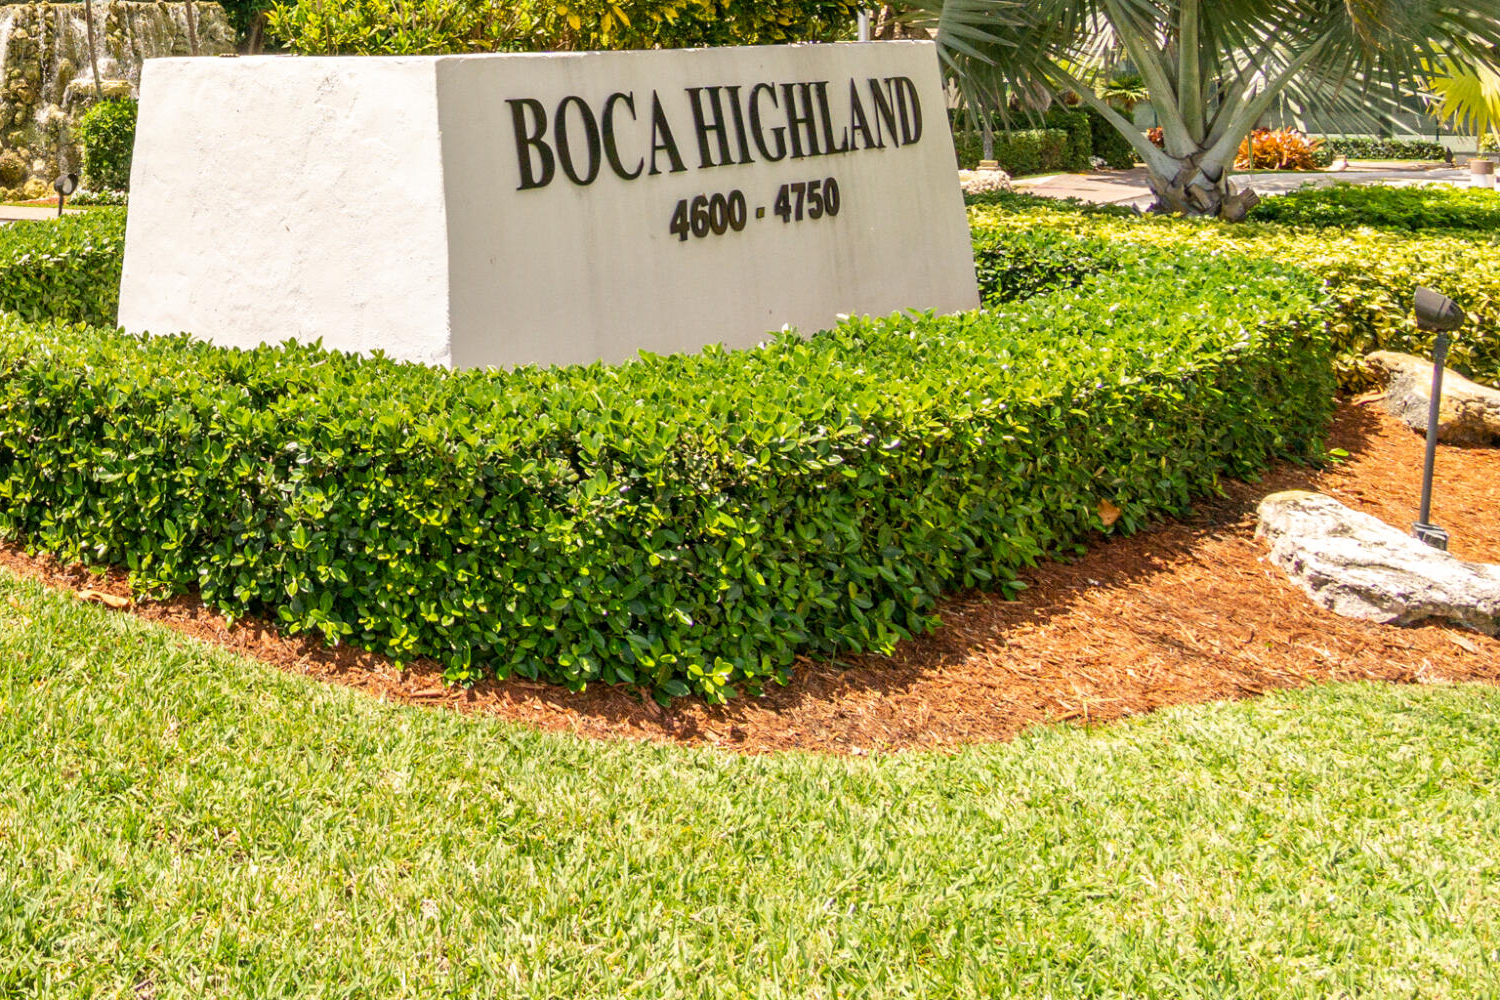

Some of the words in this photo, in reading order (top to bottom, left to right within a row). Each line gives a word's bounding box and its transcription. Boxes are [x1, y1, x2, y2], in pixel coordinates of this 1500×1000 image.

[505, 90, 687, 191] BOCA
[685, 75, 922, 169] HIGHLAND
[670, 190, 747, 241] 4600
[774, 177, 841, 223] 4750
